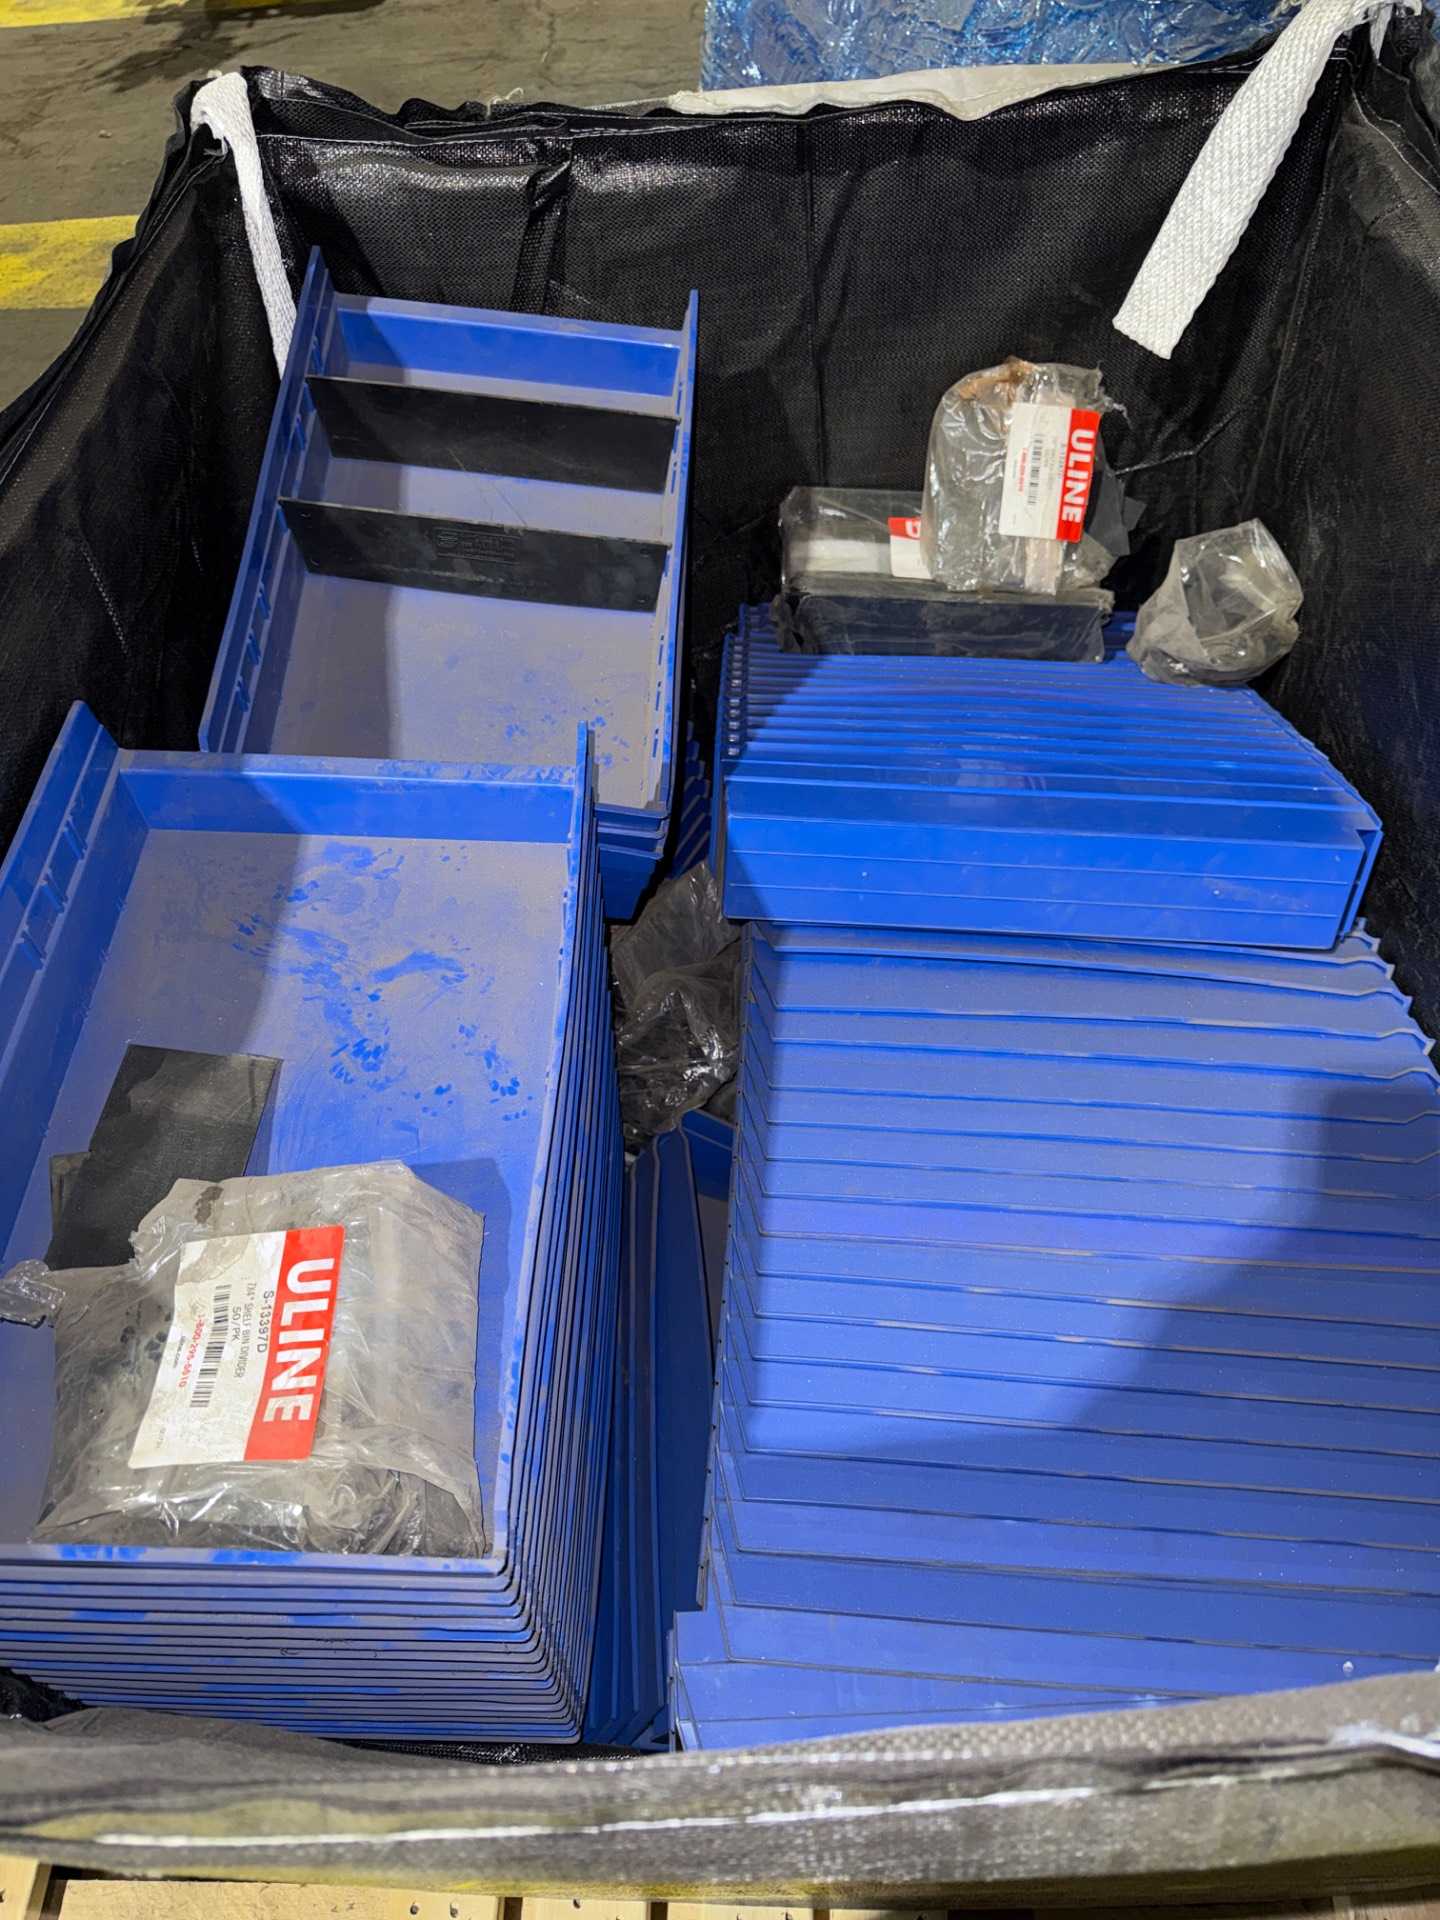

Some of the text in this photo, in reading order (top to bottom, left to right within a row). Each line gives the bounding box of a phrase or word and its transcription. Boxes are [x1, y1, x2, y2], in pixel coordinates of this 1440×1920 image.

[1062, 429, 1095, 523] ULINE
[231, 1306, 242, 1342] 50/PK
[242, 1303, 254, 1327] SHELF
[256, 1290, 274, 1353] S-13397D
[241, 1329, 251, 1344] BIN
[263, 1258, 335, 1422] ULINE
[233, 1345, 249, 1378] DIVIDER
